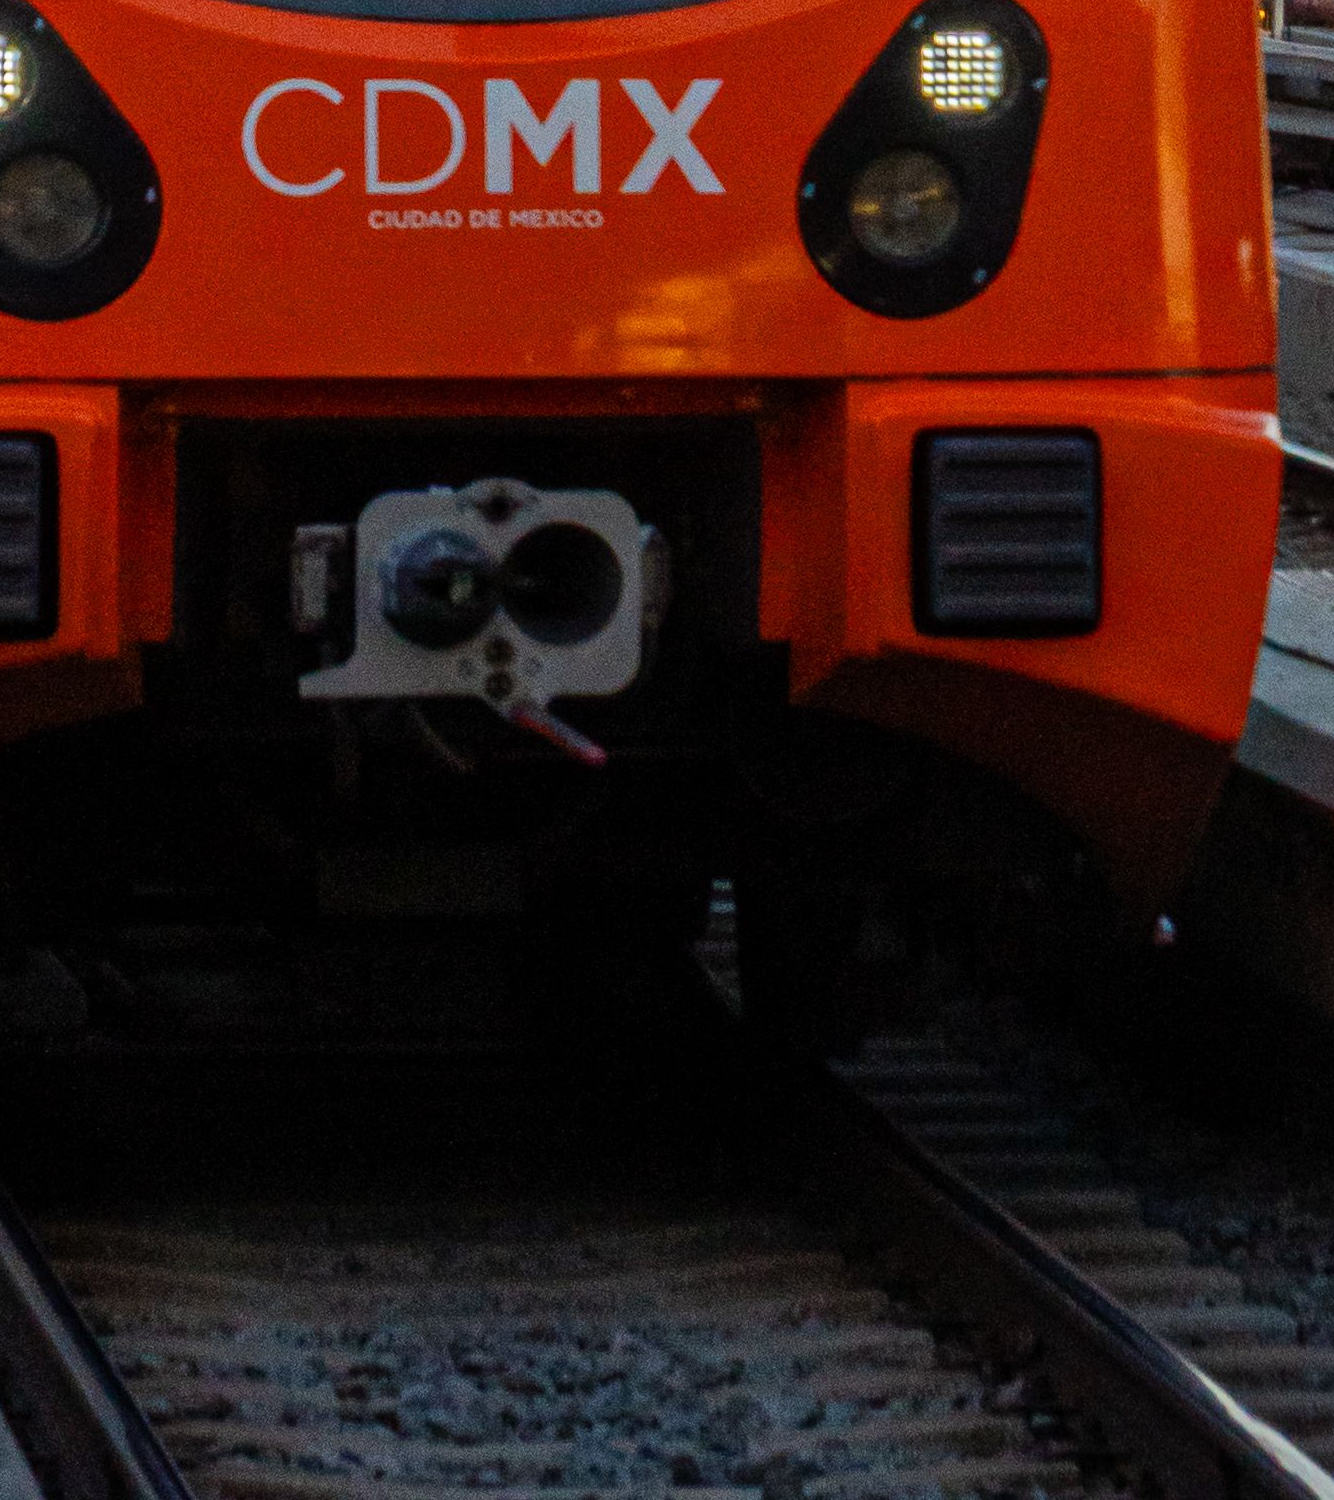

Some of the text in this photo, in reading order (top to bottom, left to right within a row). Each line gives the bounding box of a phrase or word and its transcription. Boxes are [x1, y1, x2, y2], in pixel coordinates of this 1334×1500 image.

[241, 78, 727, 197] CDMX
[368, 209, 464, 231] CIUDAD
[469, 209, 502, 230] DE
